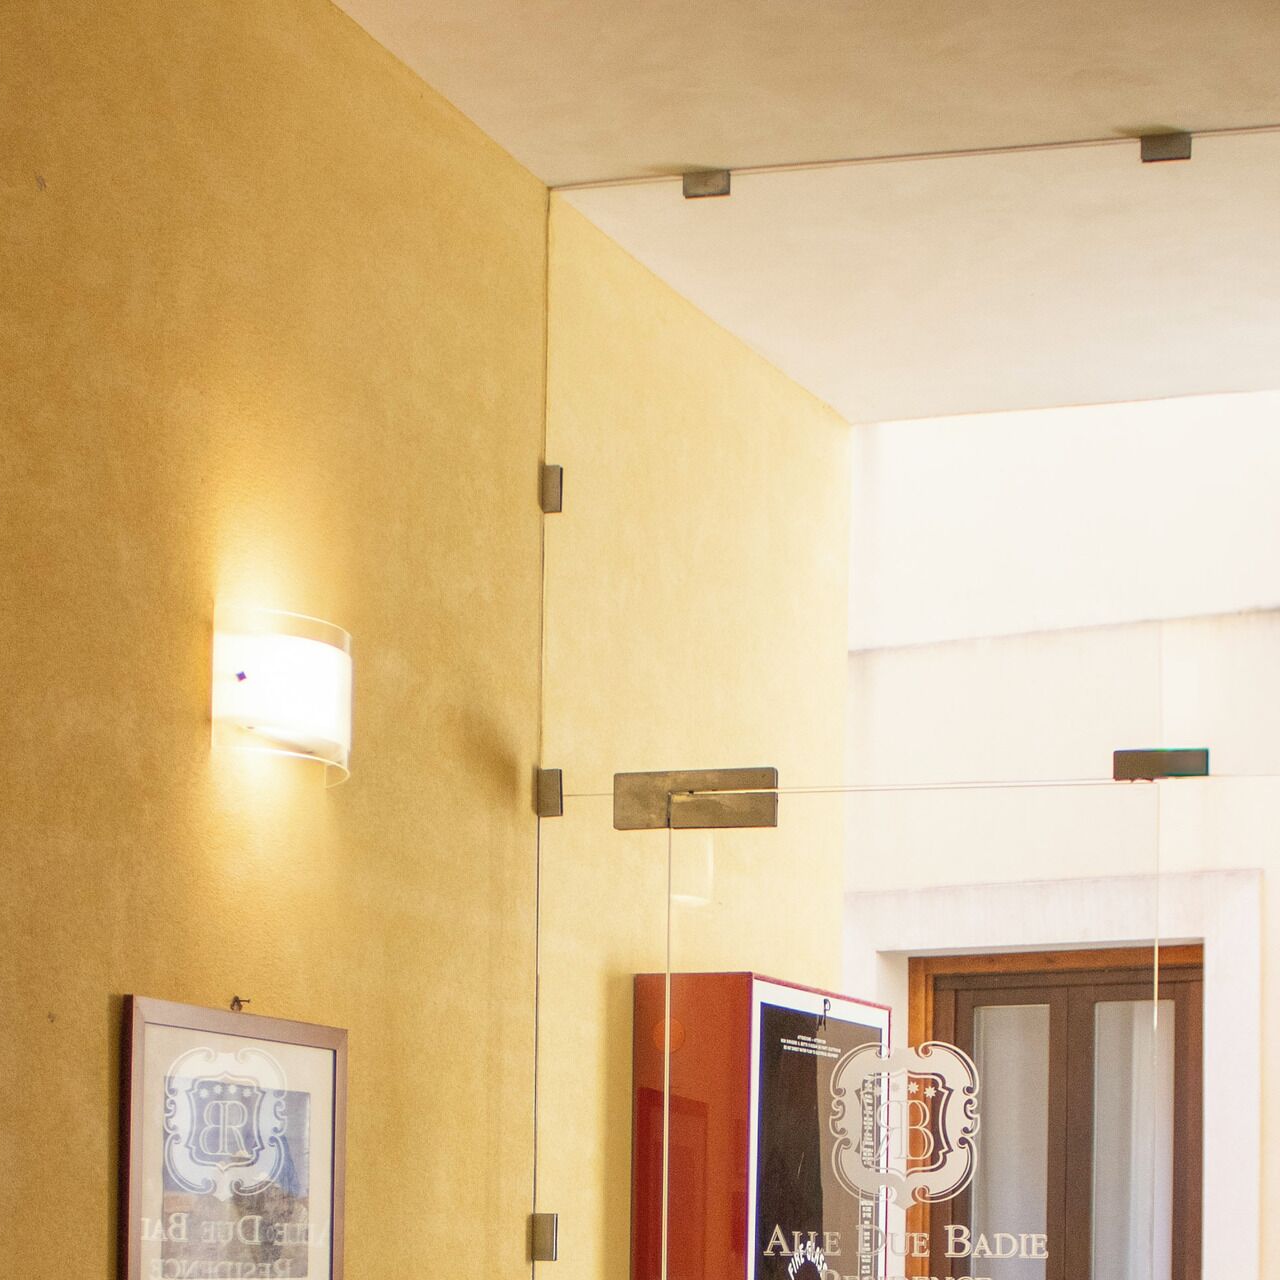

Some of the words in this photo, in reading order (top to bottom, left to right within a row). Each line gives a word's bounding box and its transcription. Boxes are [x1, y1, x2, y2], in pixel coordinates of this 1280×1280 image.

[763, 1224, 842, 1257] ALLE
[856, 1225, 930, 1258] DUE
[944, 1225, 1049, 1260] BADIE
